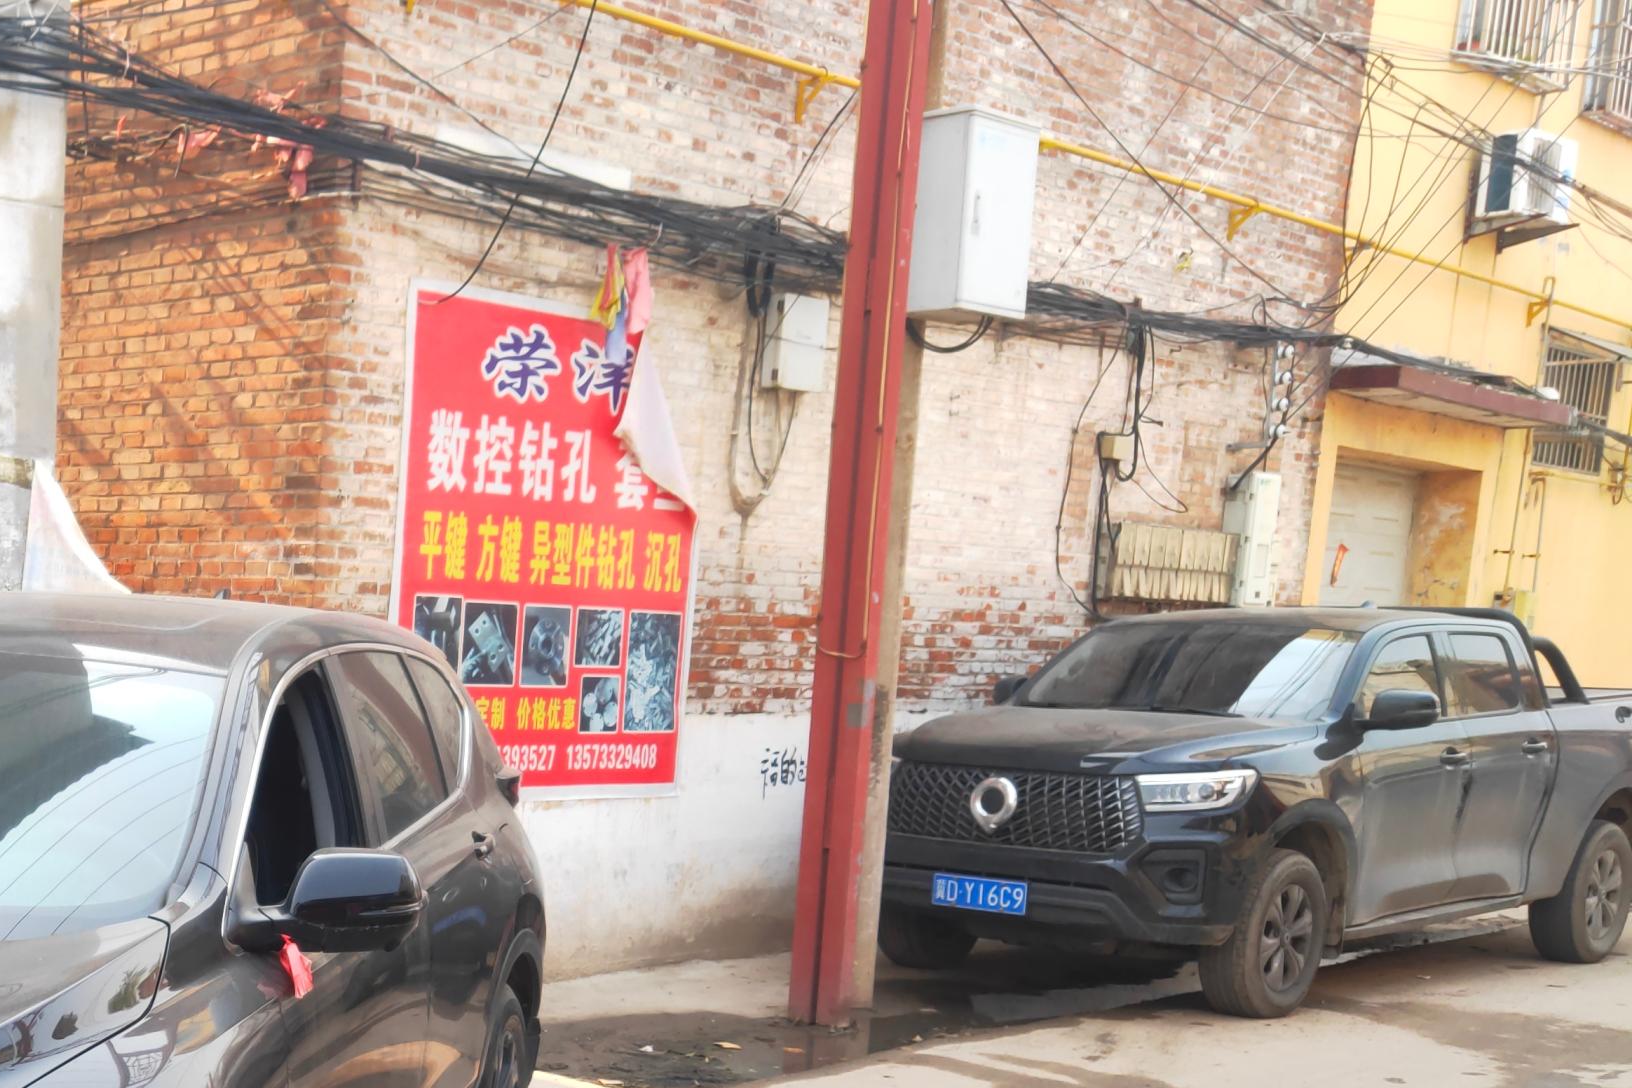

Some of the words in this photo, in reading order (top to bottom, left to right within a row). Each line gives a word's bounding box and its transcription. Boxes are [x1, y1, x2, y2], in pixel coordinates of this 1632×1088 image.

[426, 408, 597, 504] 数控钻孔
[614, 442, 686, 512] 套
[420, 510, 468, 580] 平键
[476, 514, 523, 583] 方键
[530, 520, 636, 590] 异型件钻孔
[643, 530, 682, 593] 沉孔
[517, 696, 577, 731] 价格优惠
[495, 744, 556, 771] 393527
[566, 743, 658, 770] 13573329408
